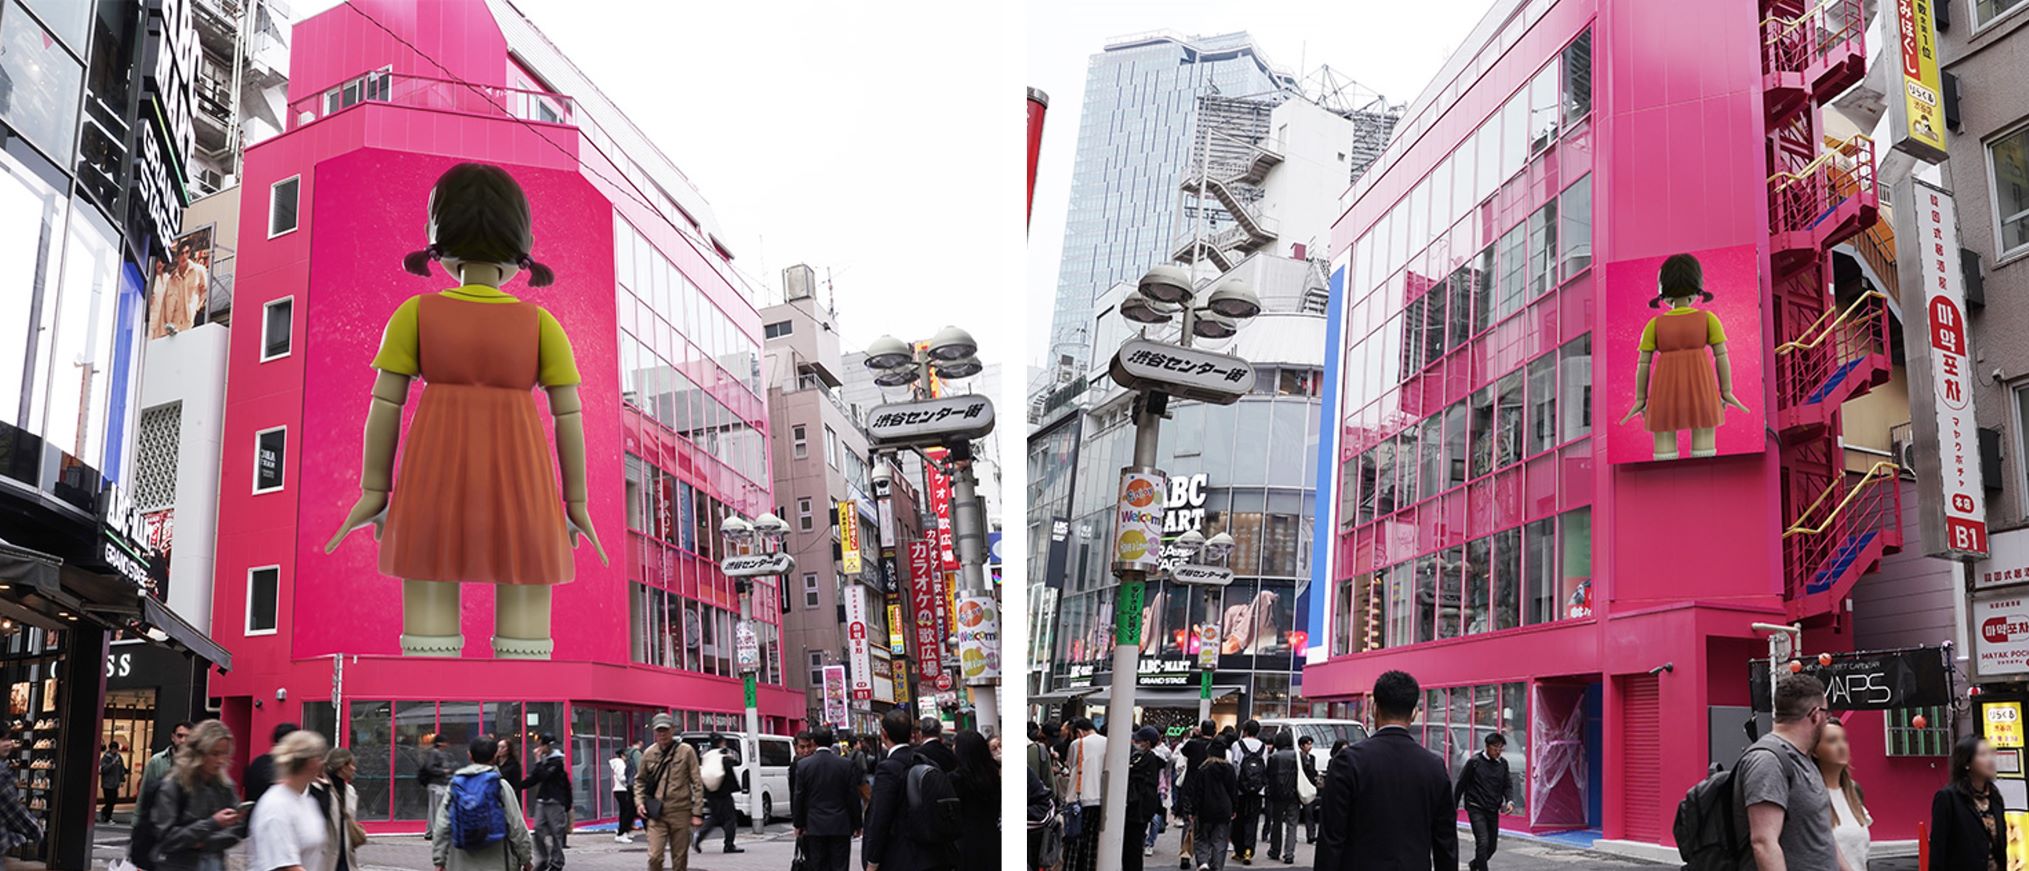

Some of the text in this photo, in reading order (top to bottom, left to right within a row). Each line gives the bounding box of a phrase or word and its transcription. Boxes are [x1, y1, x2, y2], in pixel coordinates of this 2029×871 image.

[142, 124, 182, 236] GRAND
[138, 166, 175, 263] STAGE
[1127, 349, 1248, 383] 渋谷センター街
[1936, 302, 1962, 402] 마약포차
[872, 402, 986, 428] 渋谷センター街
[1161, 507, 1205, 533] ART
[1955, 525, 1978, 551] B1
[911, 542, 932, 609] カラオケ
[1138, 659, 1191, 674] ABC-MART
